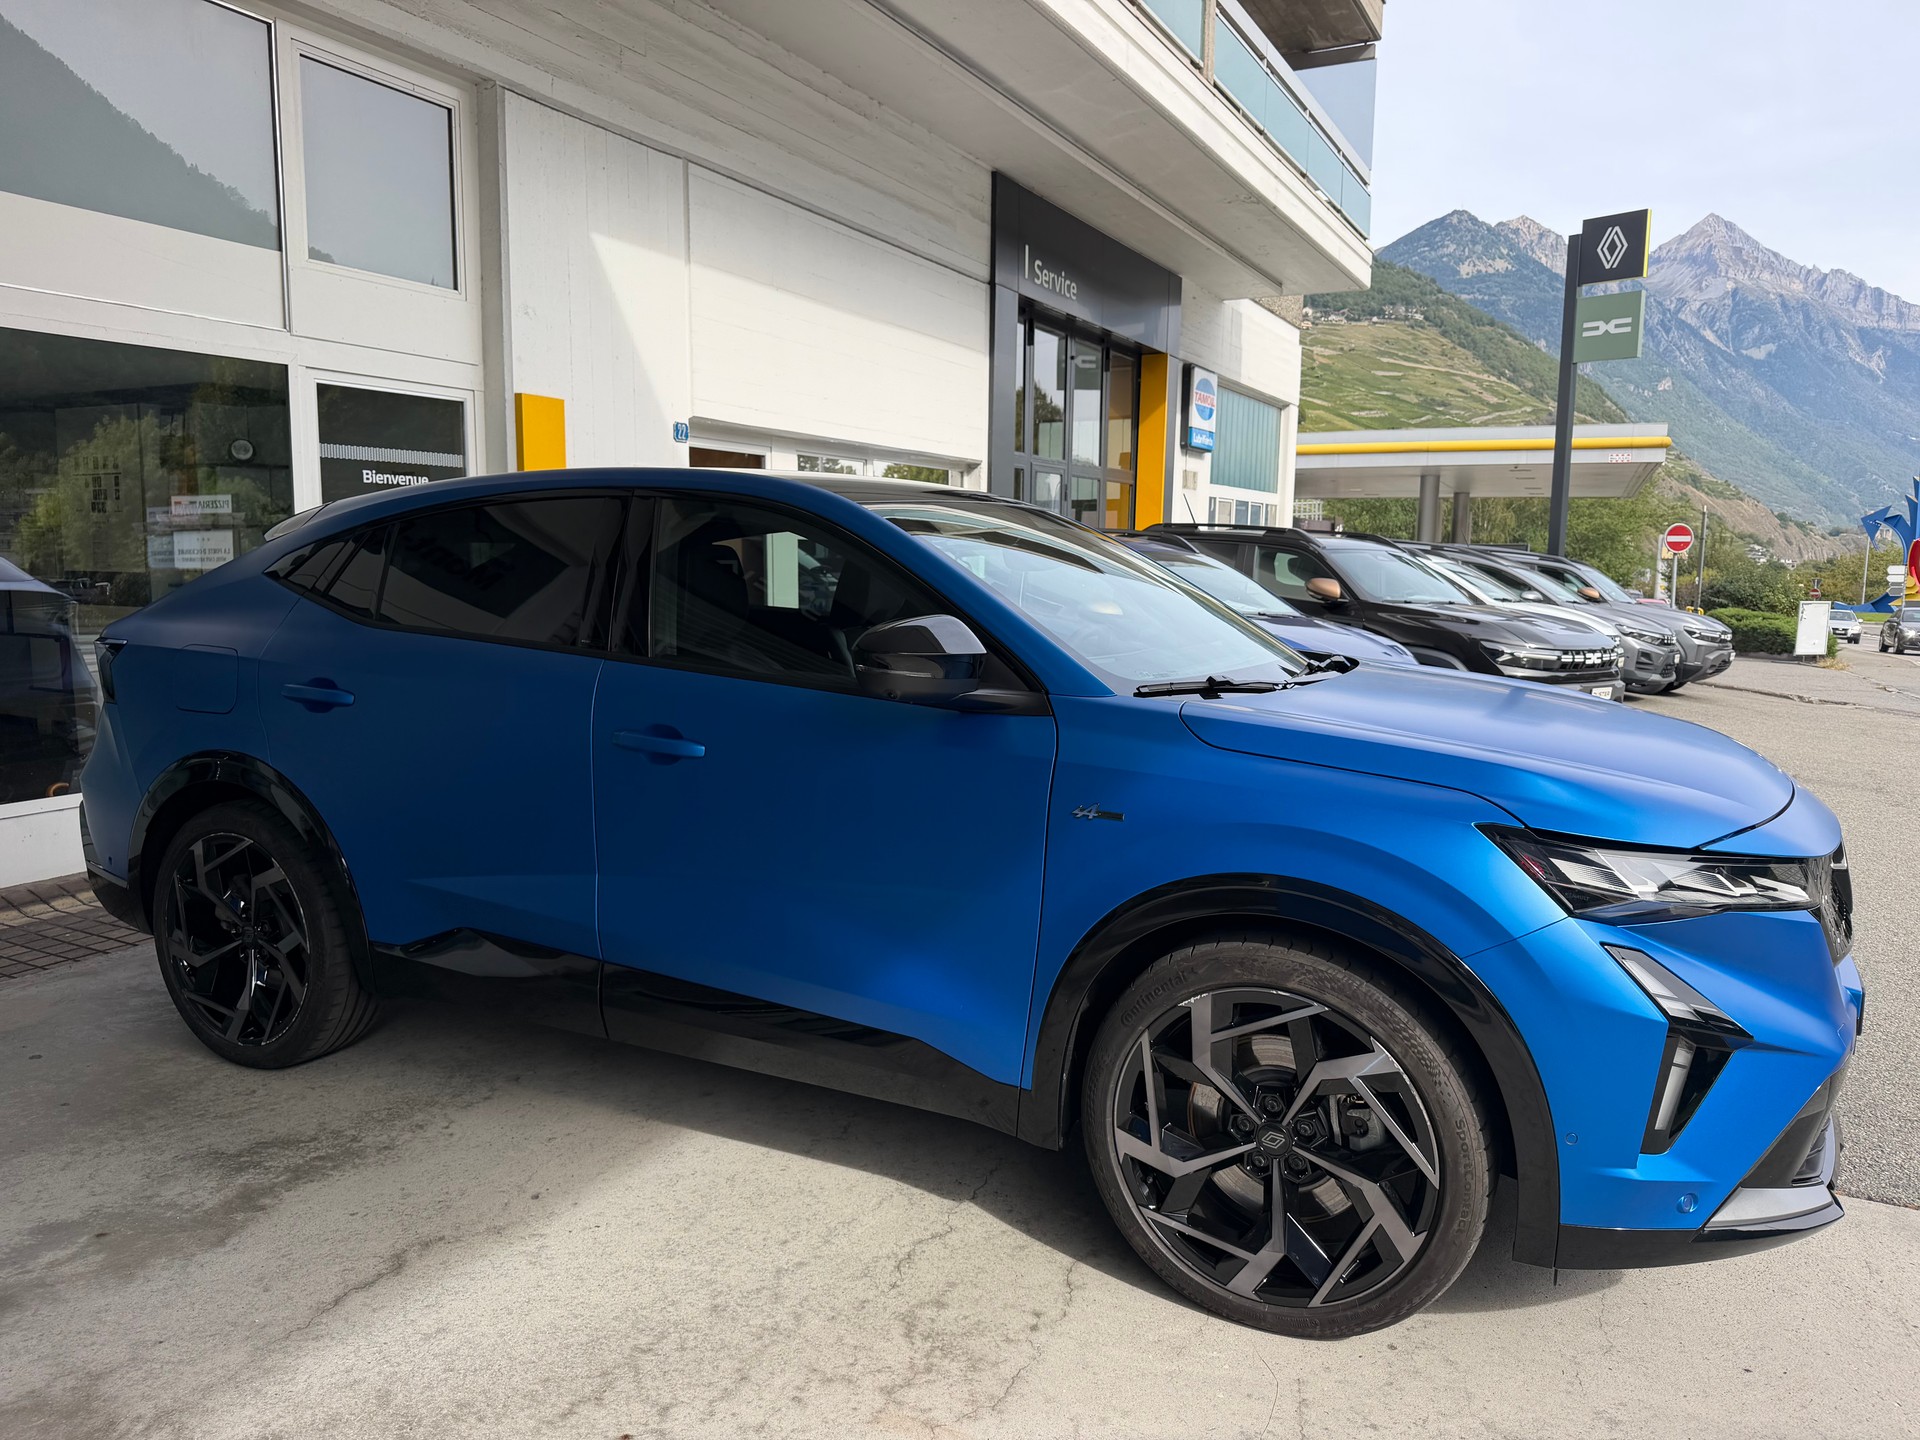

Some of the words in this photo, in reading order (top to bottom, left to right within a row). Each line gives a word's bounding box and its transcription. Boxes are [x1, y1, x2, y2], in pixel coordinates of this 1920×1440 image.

[1034, 259, 1077, 300] Service
[362, 469, 429, 486] Bienvenue
[1120, 970, 1187, 1027] Continental
[1455, 1118, 1475, 1235] SportContact
